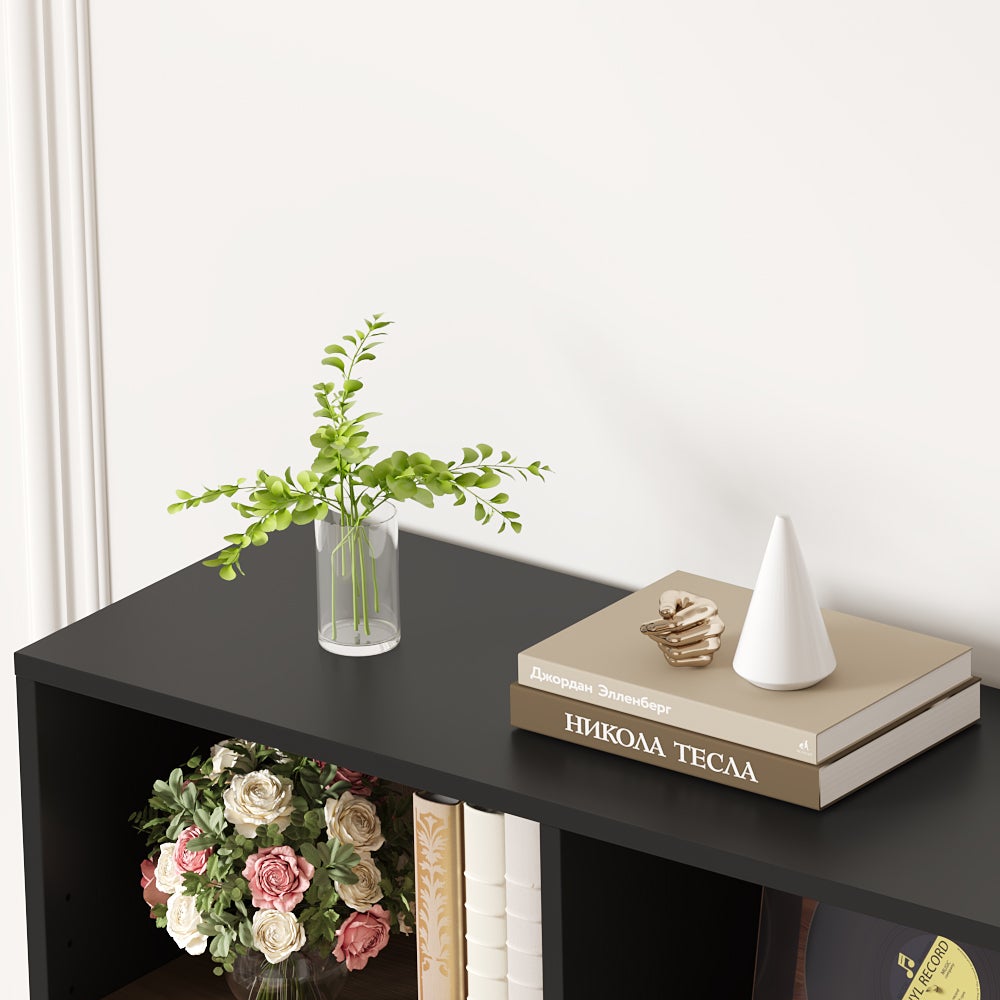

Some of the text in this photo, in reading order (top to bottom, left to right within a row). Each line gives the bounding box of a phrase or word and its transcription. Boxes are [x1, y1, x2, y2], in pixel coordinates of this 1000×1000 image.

[530, 666, 672, 715] Джордан Элленберг
[564, 712, 759, 784] НИКОЛА ТЕСЛА
[919, 940, 949, 987] RECORD
